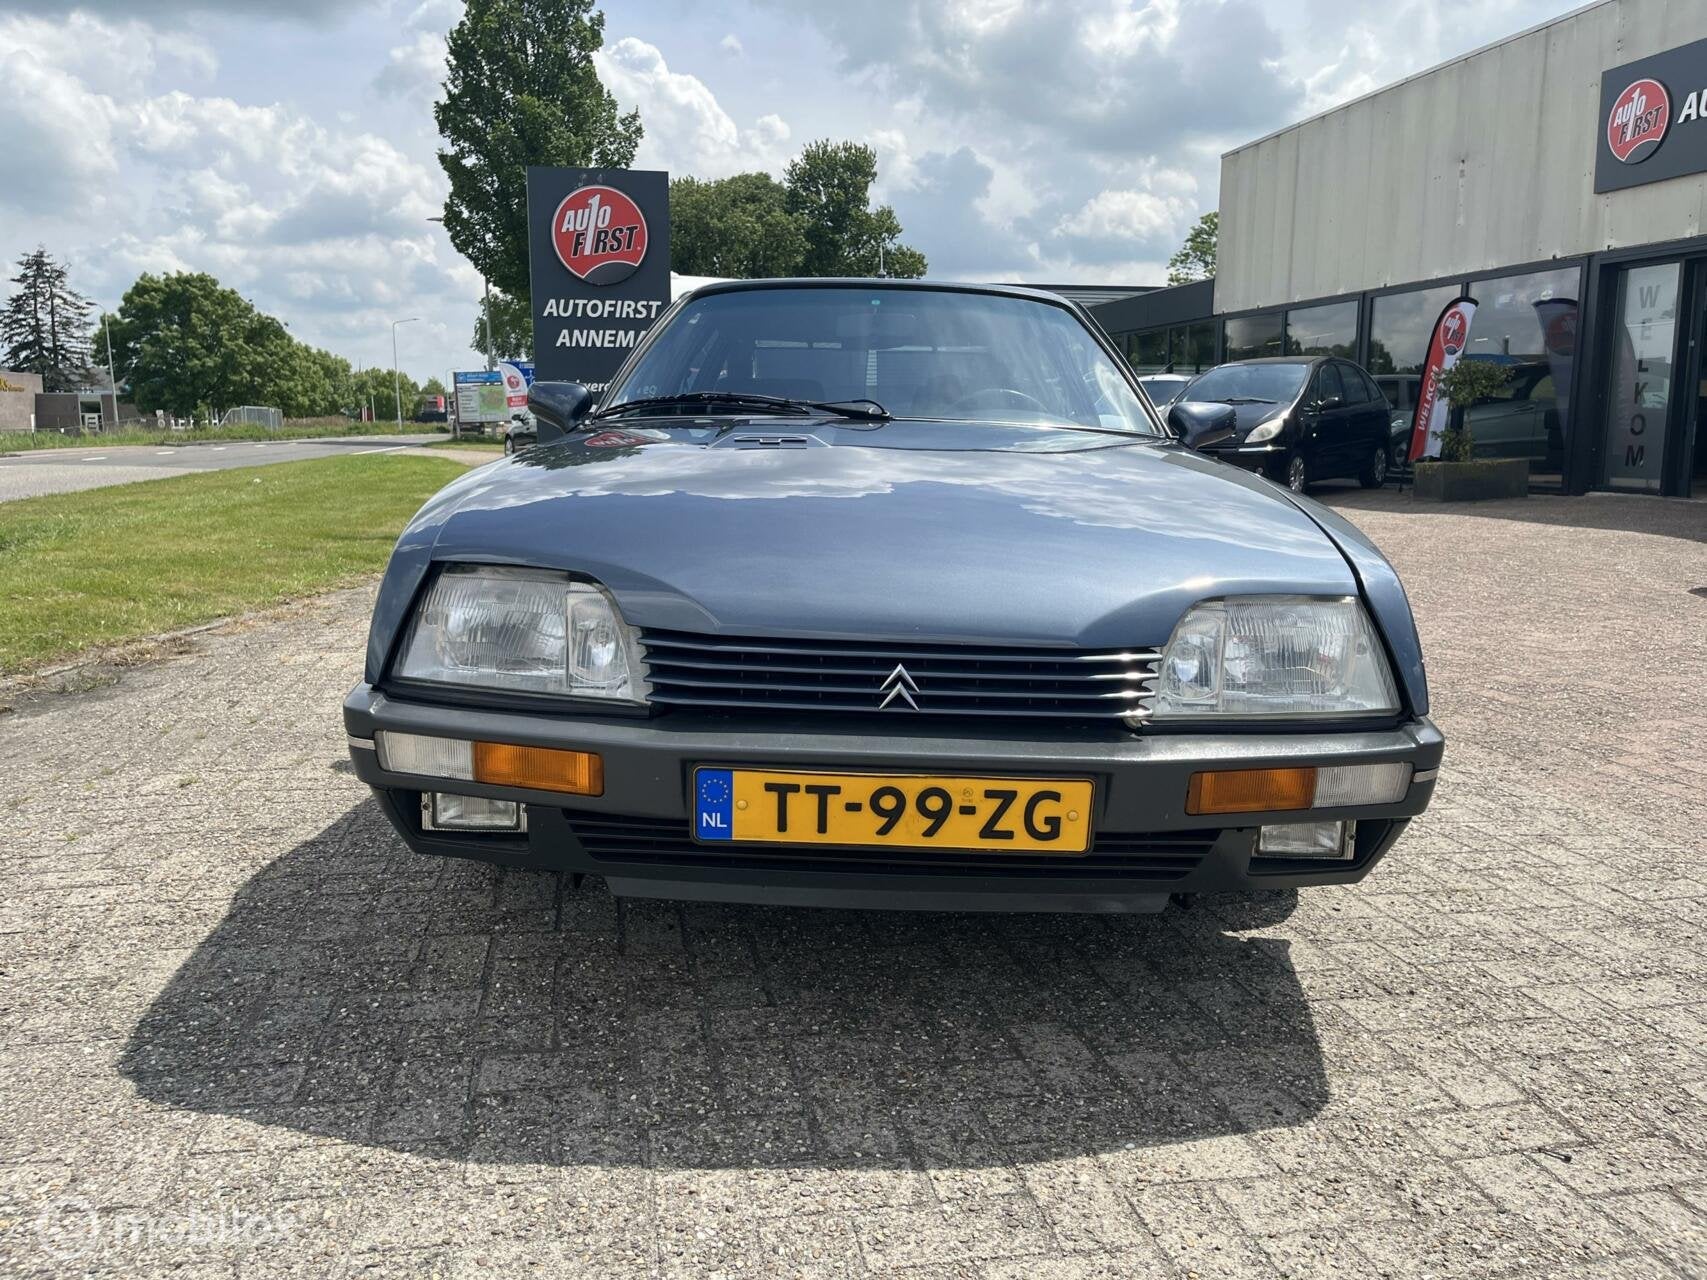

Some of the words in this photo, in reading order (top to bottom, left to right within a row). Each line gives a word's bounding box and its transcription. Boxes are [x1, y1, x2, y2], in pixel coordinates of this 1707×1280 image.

[1613, 90, 1647, 127] AUTO
[1617, 104, 1664, 146] FIRST
[561, 196, 612, 233] AUTO
[571, 224, 640, 258] FIRST
[542, 298, 662, 319] AUTOFIRST
[1624, 284, 1661, 468] WELKOM
[702, 812, 728, 829] NL
[763, 782, 1062, 842] TT-99-ZG
